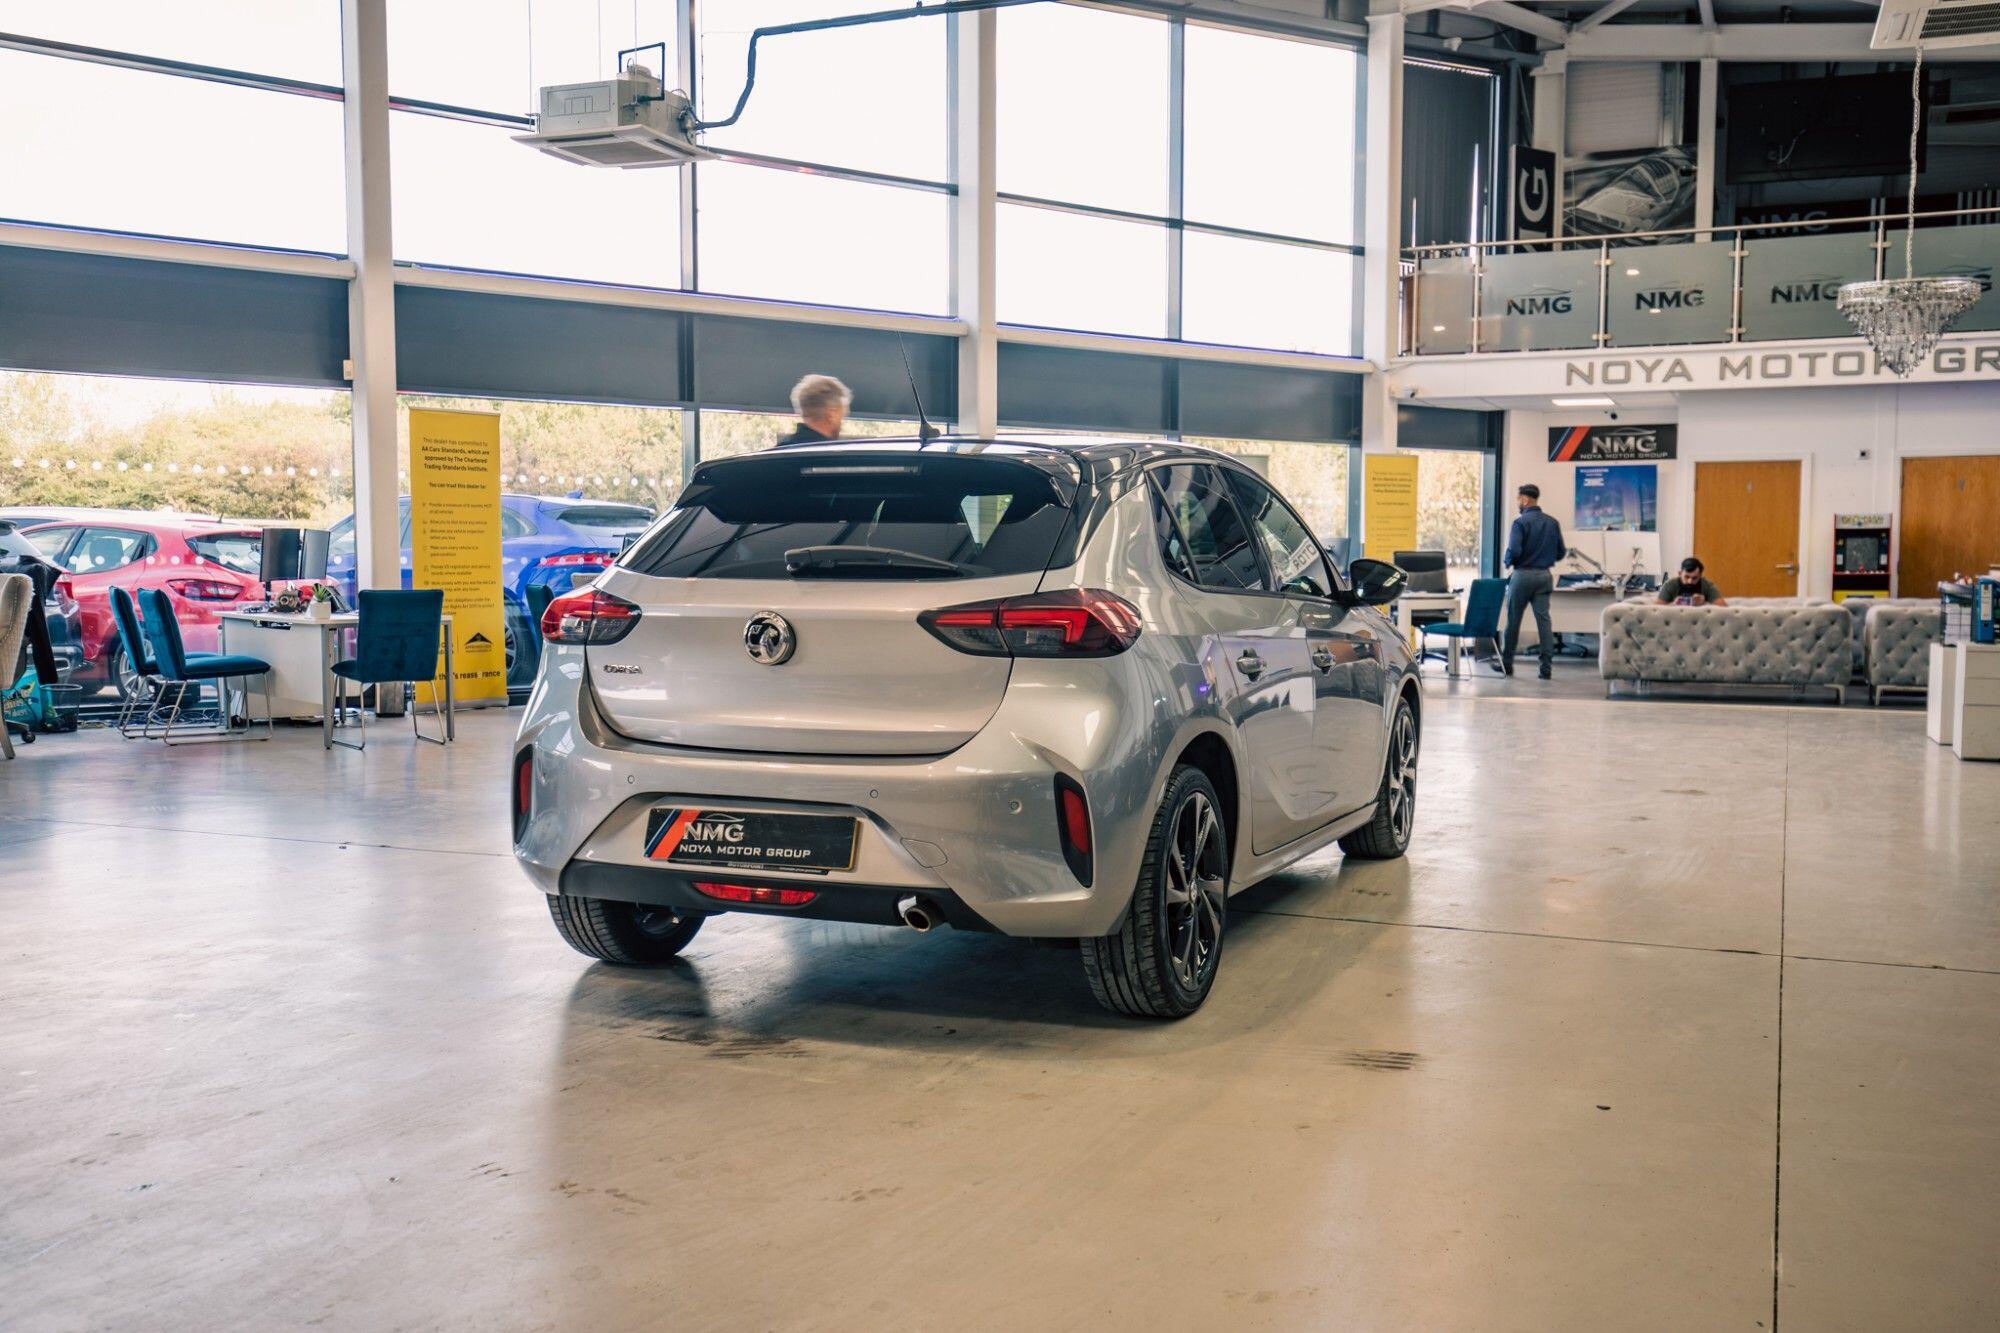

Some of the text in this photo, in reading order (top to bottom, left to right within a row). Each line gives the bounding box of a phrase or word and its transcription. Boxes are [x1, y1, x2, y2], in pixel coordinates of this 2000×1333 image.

[1635, 289, 1705, 310] NMG
[1771, 282, 1842, 304] NMG
[1507, 296, 1572, 316] NMG
[1566, 357, 1693, 387] NOYA
[1592, 435, 1657, 454] NMG
[1580, 452, 1602, 460] NOYA
[460, 670, 501, 679] reassrance
[683, 821, 745, 842] NMG
[679, 844, 811, 858] NOYA MOTOR GROUP
